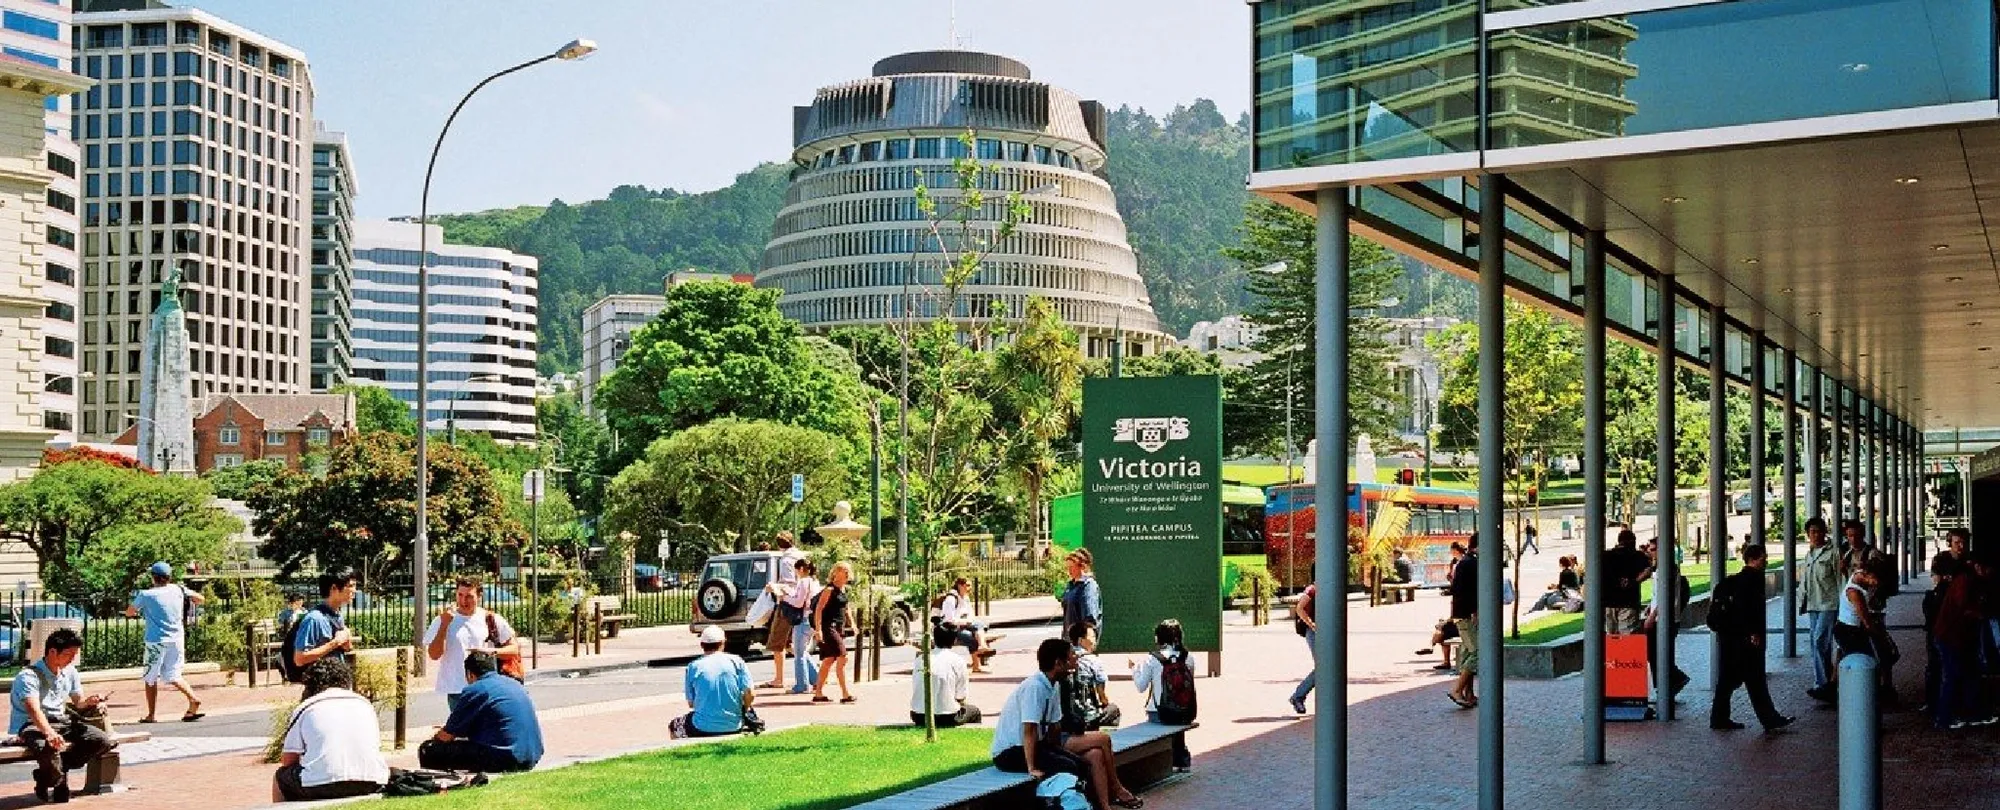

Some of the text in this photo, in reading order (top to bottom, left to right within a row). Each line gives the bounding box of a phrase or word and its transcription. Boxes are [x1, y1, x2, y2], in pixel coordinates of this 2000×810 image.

[1099, 456, 1201, 479] Victoria
[1092, 481, 1210, 493] University of Wellington
[1110, 523, 1193, 533] PIPITEA CAMPUS
